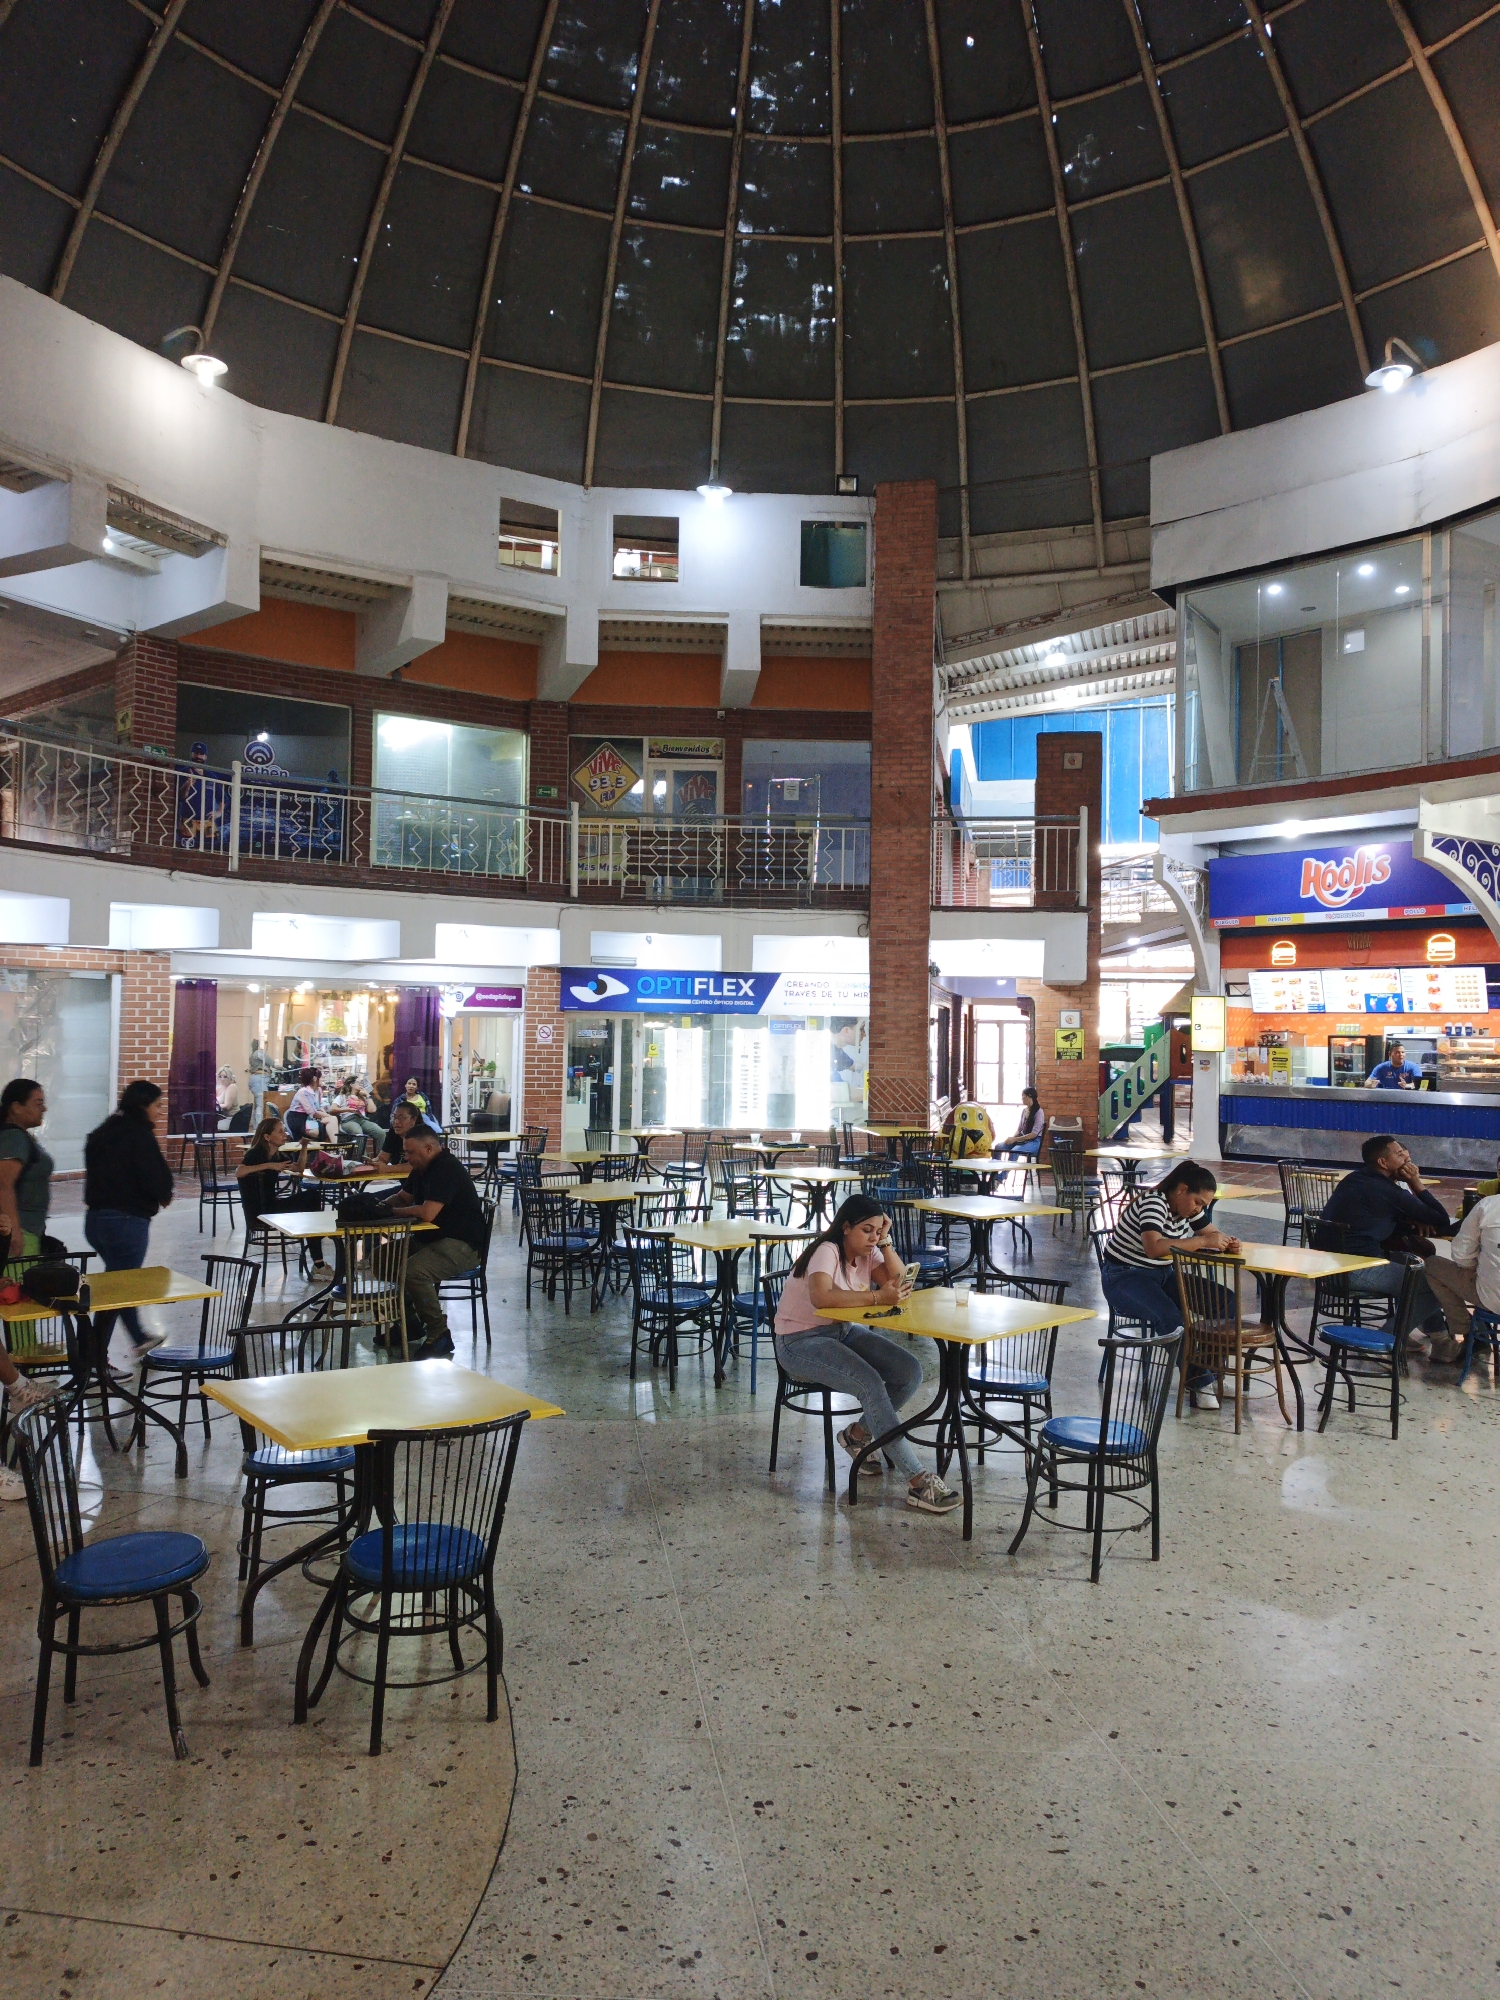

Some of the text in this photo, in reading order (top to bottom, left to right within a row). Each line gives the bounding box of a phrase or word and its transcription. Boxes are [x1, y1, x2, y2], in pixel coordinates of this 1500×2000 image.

[662, 744, 710, 753] Bienvenidos
[588, 775, 627, 792] 93.3
[600, 790, 616, 803] FM
[637, 976, 756, 997] OPTIFLEX
